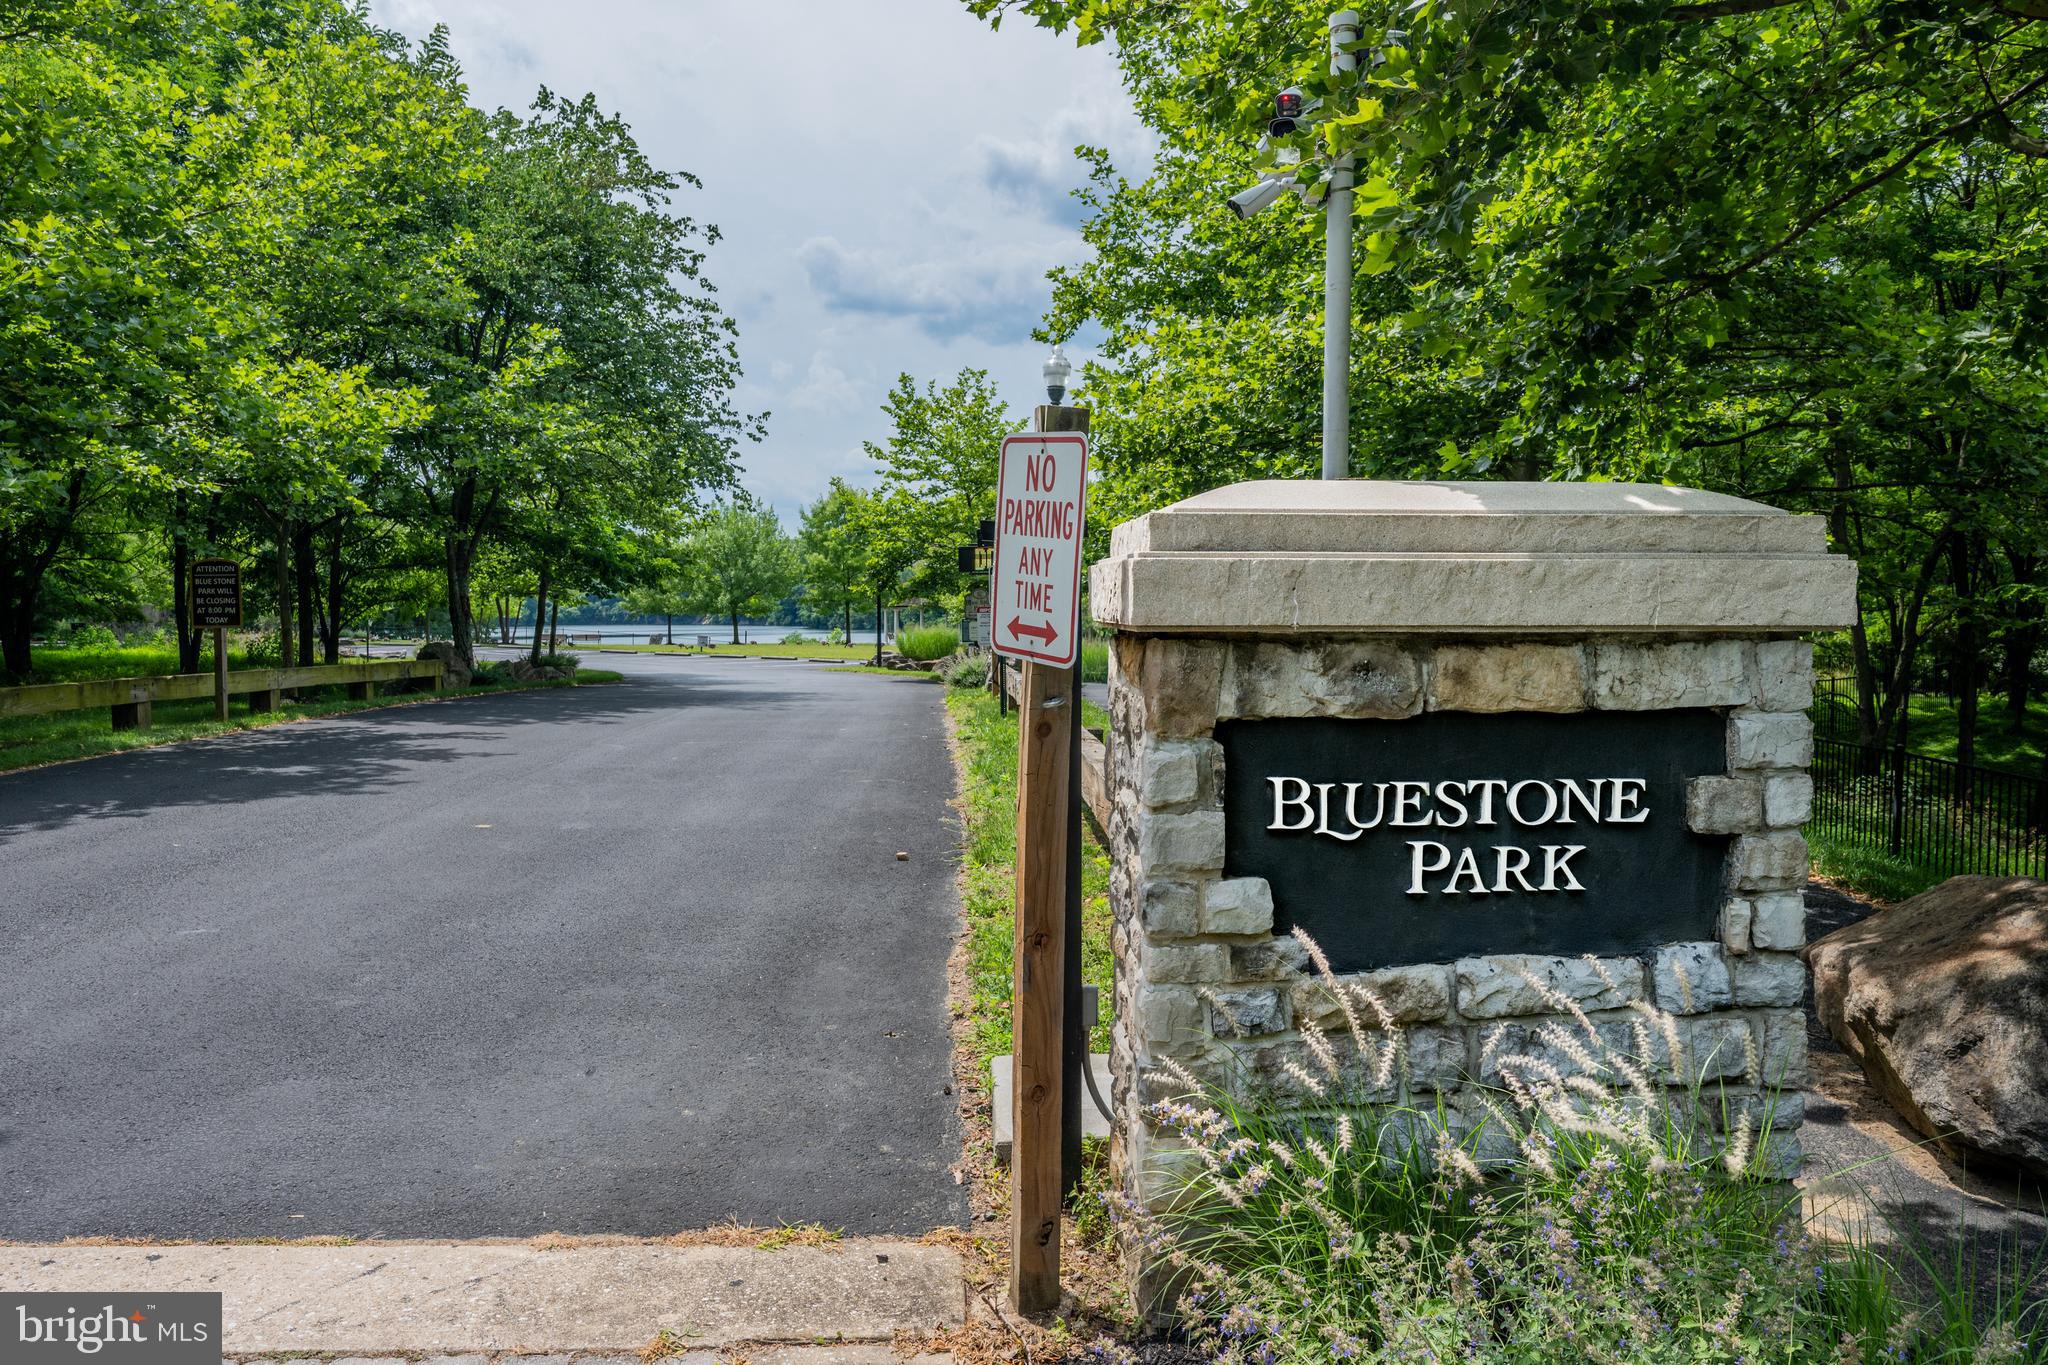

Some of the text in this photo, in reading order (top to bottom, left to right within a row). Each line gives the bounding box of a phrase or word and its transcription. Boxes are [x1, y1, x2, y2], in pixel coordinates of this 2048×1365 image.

[1026, 455, 1056, 492] NO
[1004, 498, 1074, 540] PARKING
[1018, 546, 1054, 577] ANY
[1015, 580, 1054, 614] TIME
[1266, 776, 1650, 841] BLUESTONE
[1405, 840, 1587, 893] PARK
